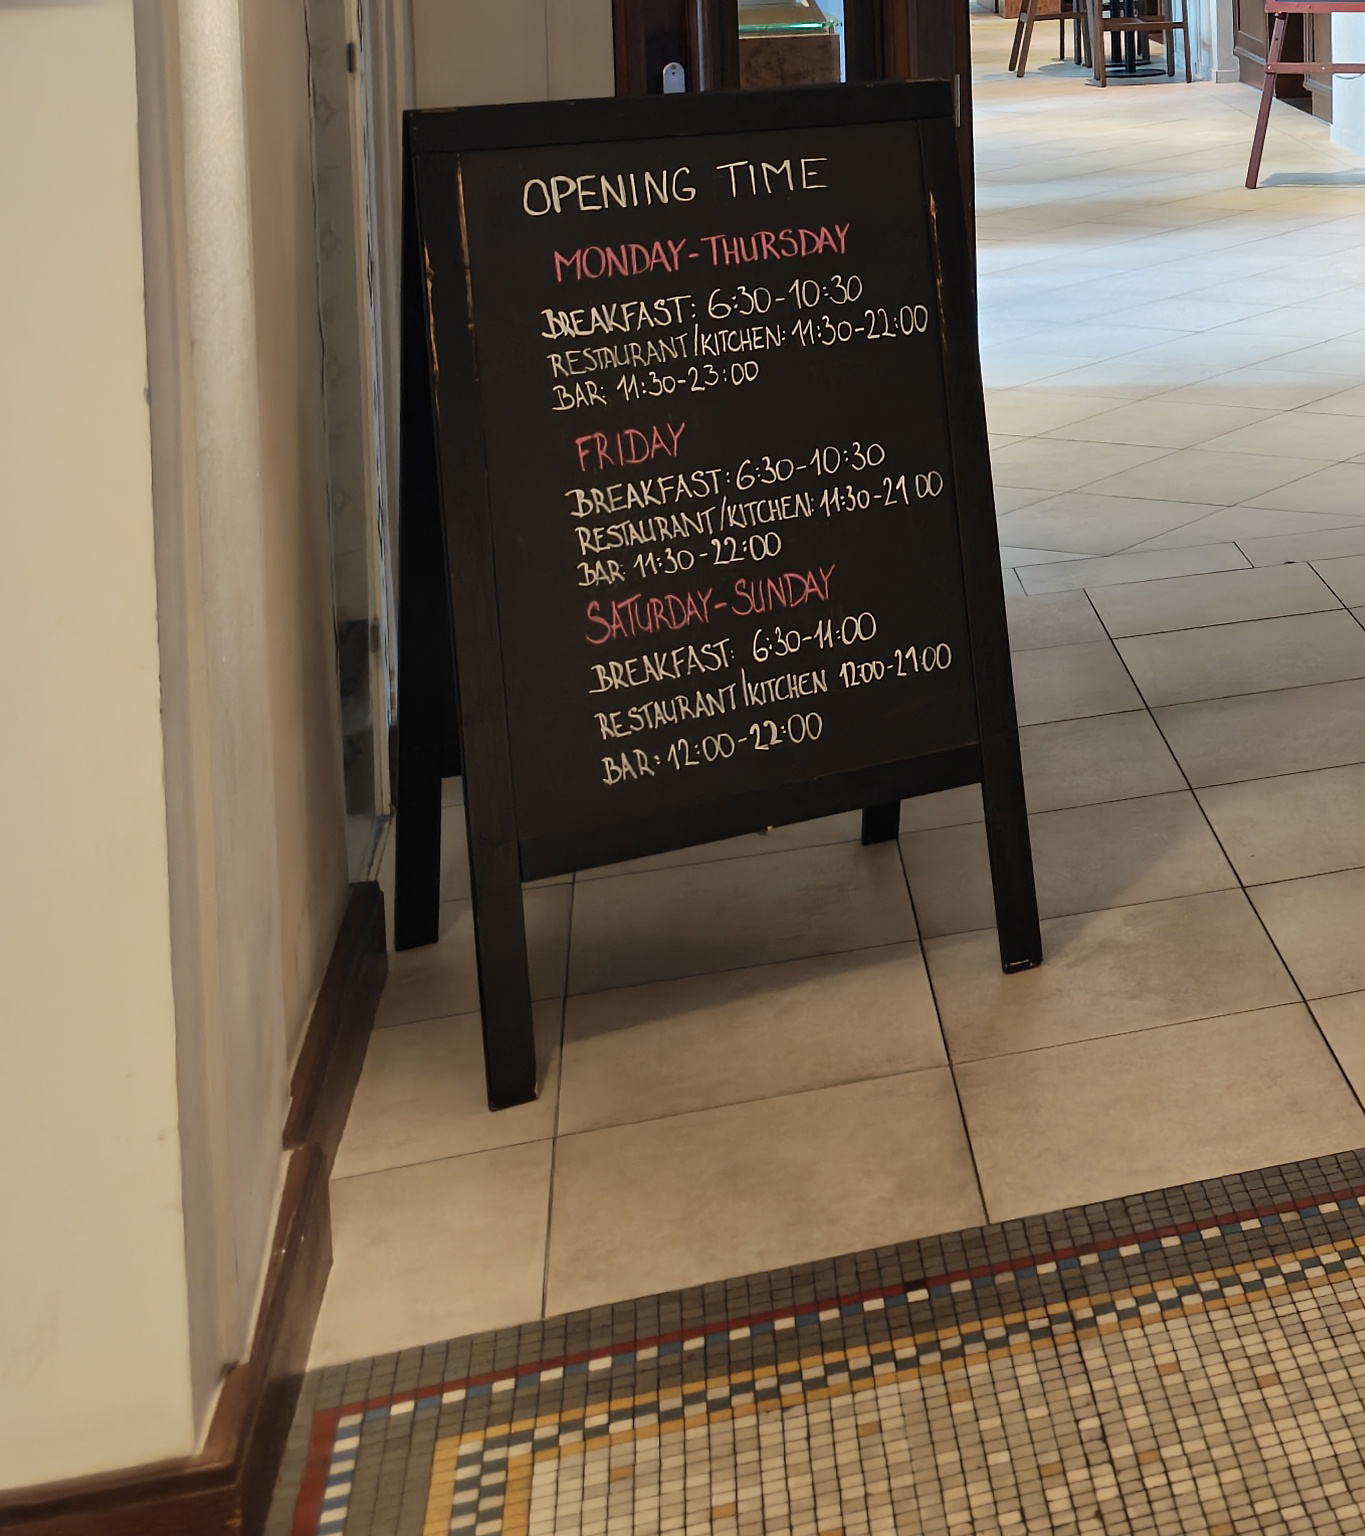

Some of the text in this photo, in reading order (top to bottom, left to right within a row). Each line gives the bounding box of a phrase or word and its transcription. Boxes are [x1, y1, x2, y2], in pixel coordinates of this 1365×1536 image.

[523, 157, 829, 217] OPENING TIME
[553, 223, 851, 283] MONDAY-THURSDAY
[540, 274, 864, 340] BREAKFAST: 6:30-10:30
[547, 304, 929, 378] RESTAURANT/KITCHEN: 11:30-22:00
[551, 360, 759, 412] BAR: 11:30-23:00
[575, 422, 686, 472] FRIDAY
[565, 441, 886, 519] BREAKFAST: 6:30-10:30
[575, 495, 816, 556] RESTAURANT/KITCHEN:
[577, 532, 782, 587] BAR: 11:30-22:00
[585, 563, 837, 645] SATURDAY-SUNDAY
[589, 612, 877, 694] BREAKFAST: 6:30-11:00
[601, 712, 823, 786] BAR: 12:00-22:00
